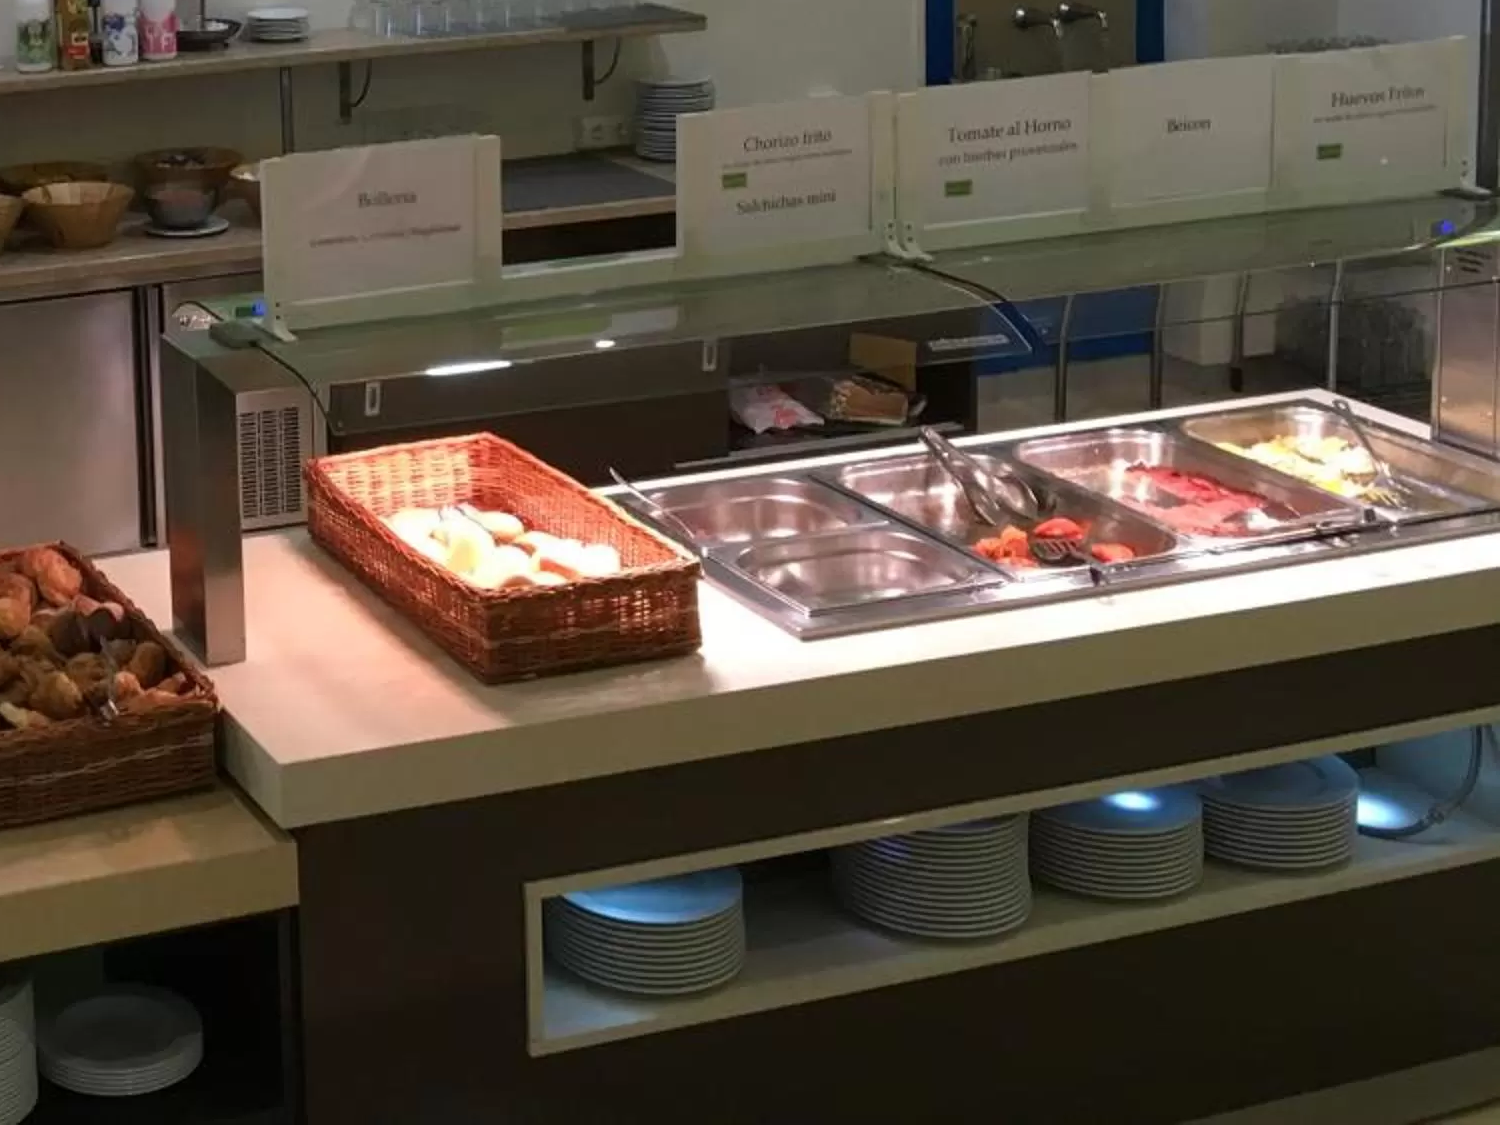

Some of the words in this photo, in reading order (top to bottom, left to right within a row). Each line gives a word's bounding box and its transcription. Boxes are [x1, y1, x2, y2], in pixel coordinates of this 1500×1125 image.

[948, 126, 1004, 144] Tomate
[1005, 119, 1021, 137] al
[1023, 118, 1073, 136] Horno
[742, 134, 799, 153] Chorizo
